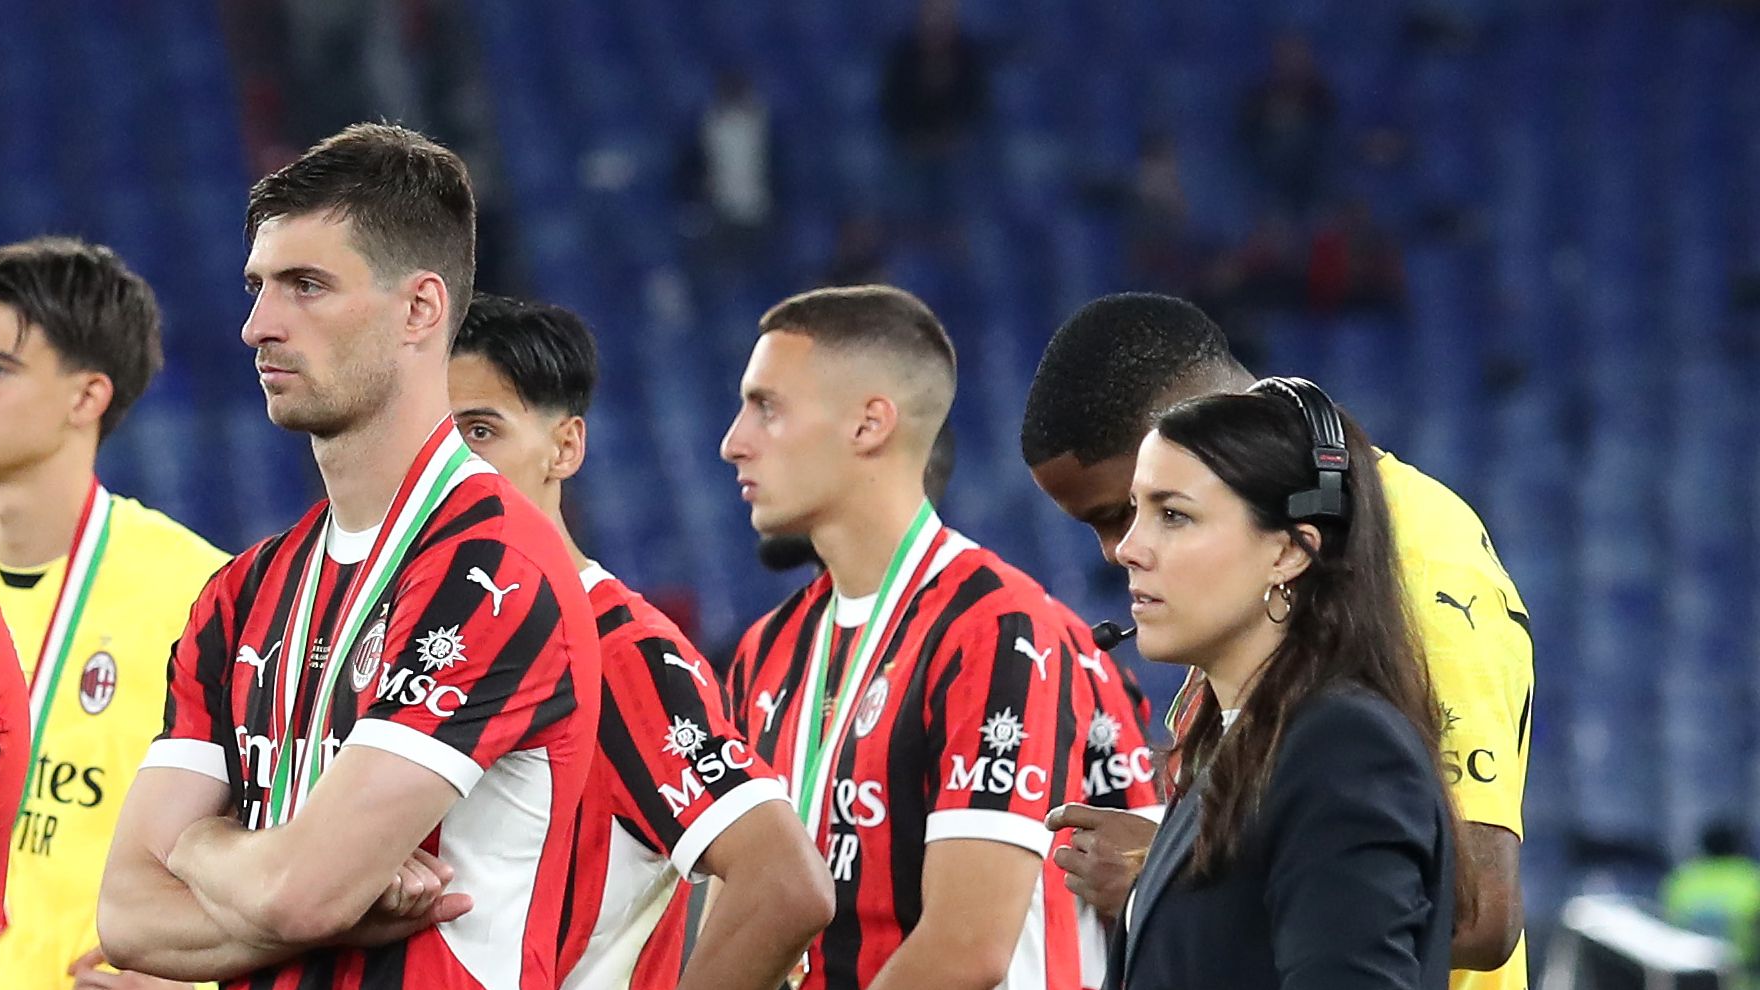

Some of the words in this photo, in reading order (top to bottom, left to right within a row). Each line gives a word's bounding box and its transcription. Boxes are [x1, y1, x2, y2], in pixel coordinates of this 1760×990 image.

[376, 662, 468, 717] MSC
[658, 739, 754, 817] MSC
[946, 755, 1048, 801] MSC
[1083, 747, 1157, 797] MSC
[1440, 749, 1497, 784] SC
